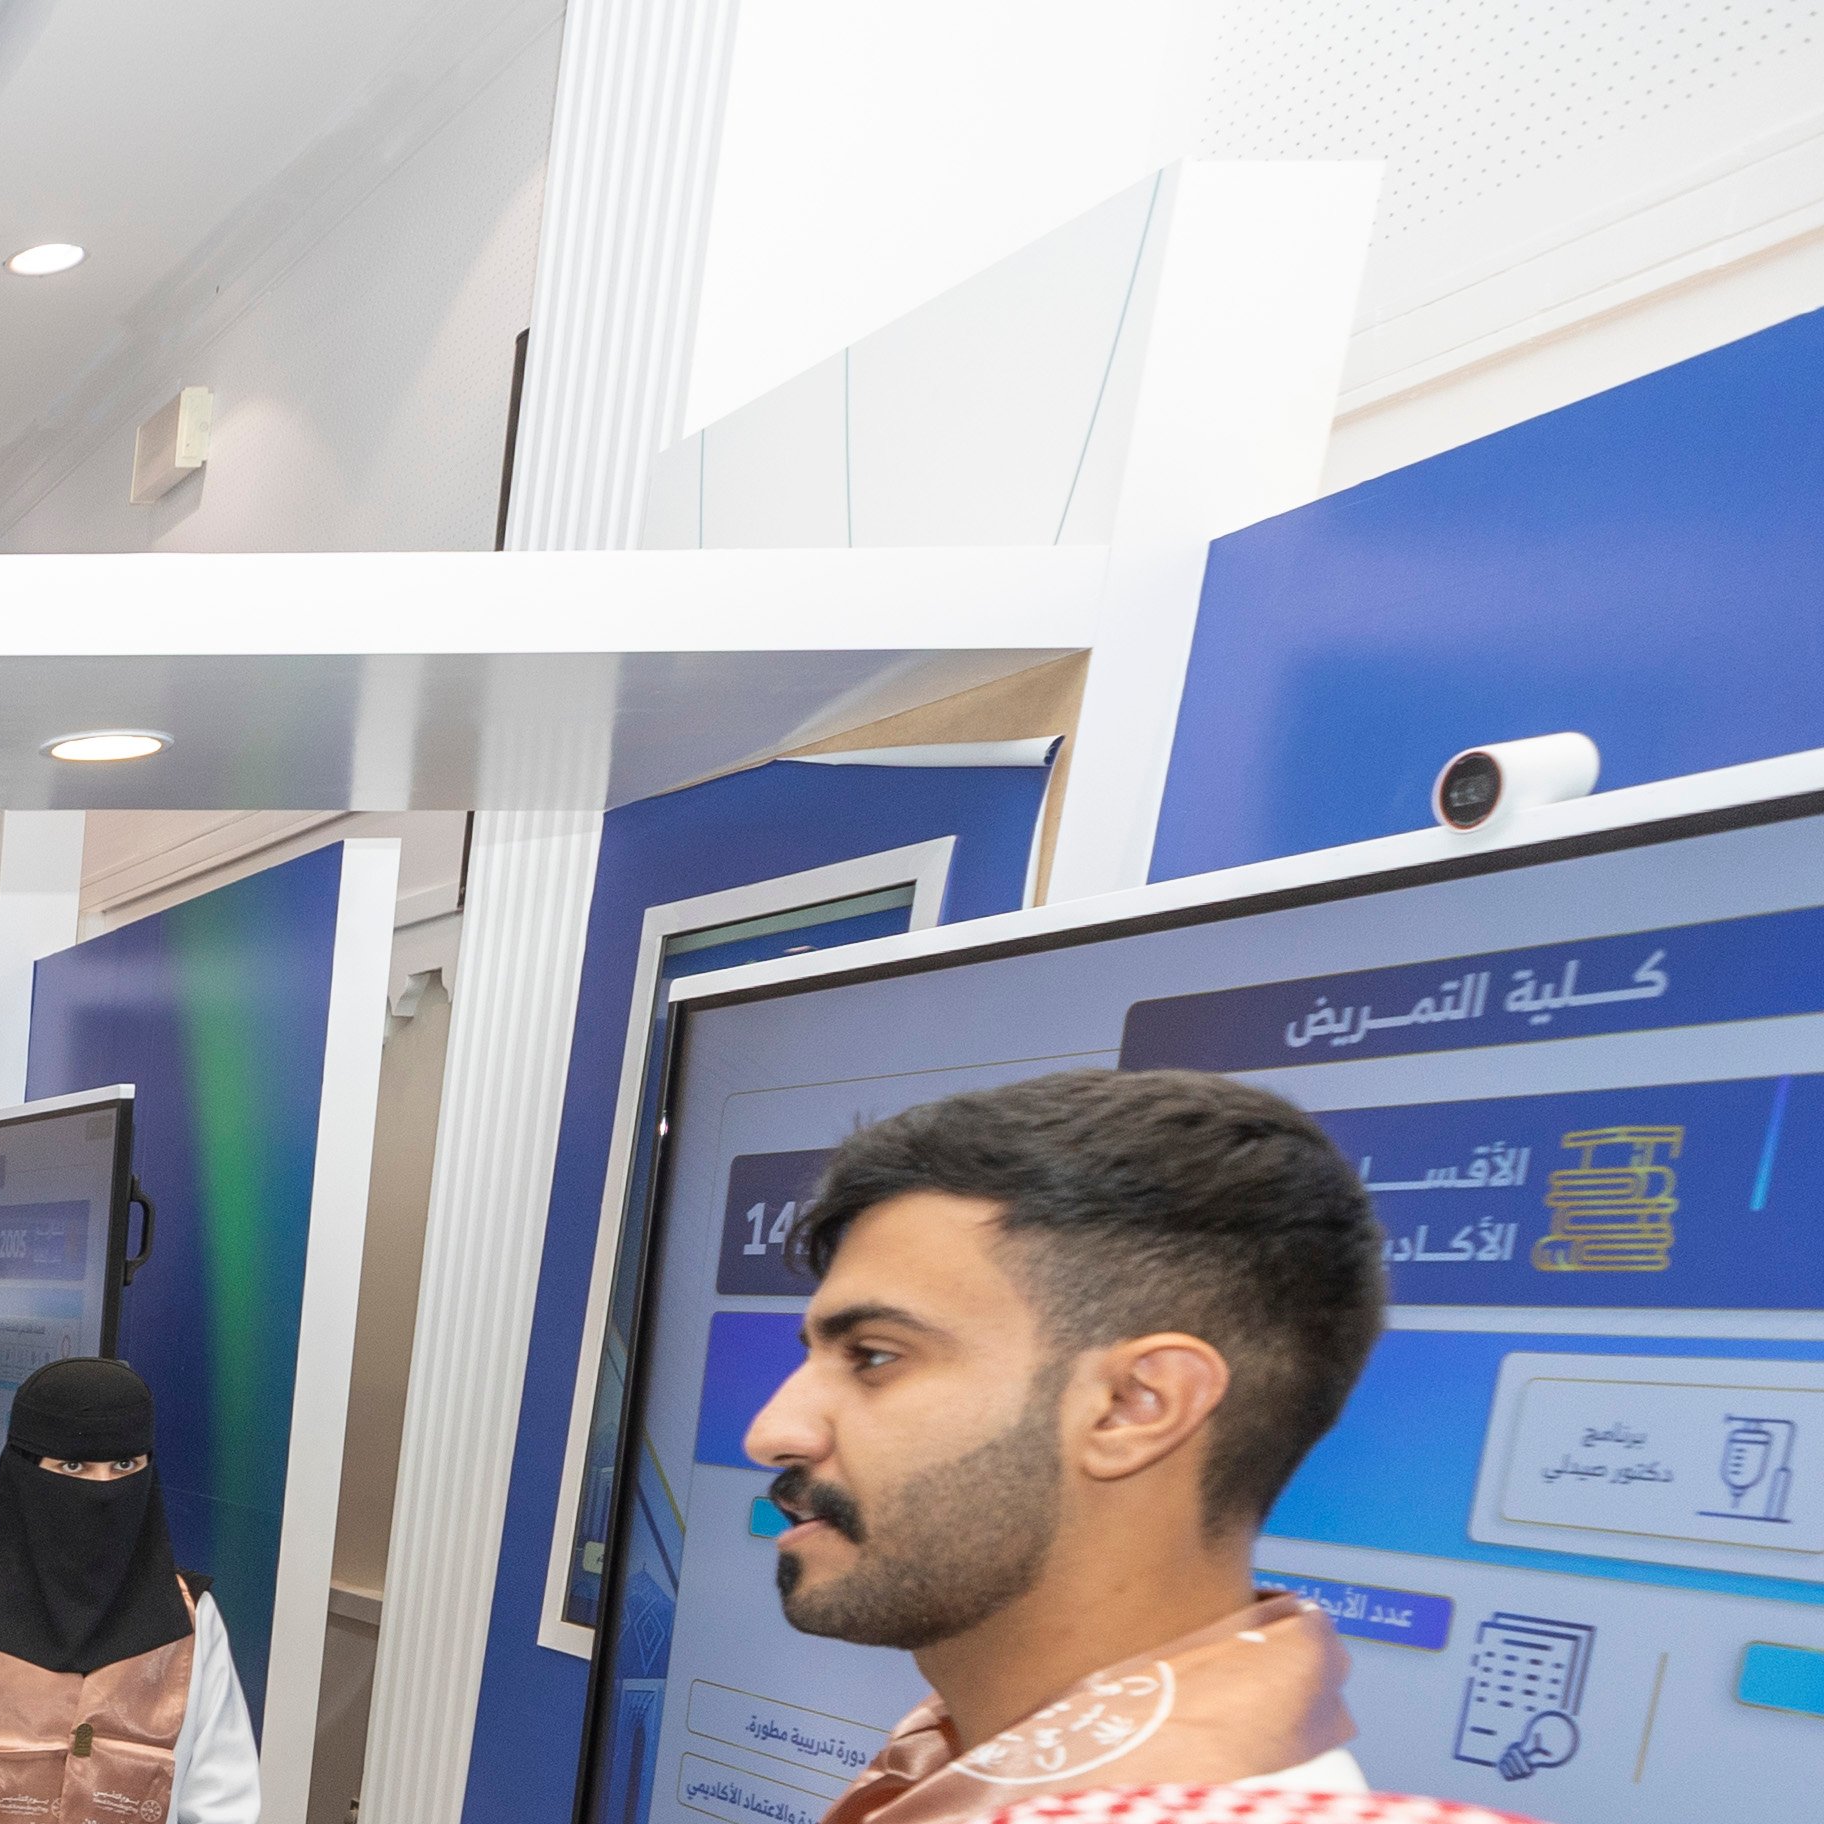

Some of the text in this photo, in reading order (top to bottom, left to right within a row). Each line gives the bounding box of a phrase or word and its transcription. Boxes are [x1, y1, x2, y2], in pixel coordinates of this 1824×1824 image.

[1283, 949, 1670, 1050] كلية التمريض
[1358, 1139, 1532, 1193] الأقسا
[1369, 1607, 1416, 1629] عدد
[790, 1727, 836, 1758] تدريبية
[836, 1739, 867, 1767] دورة
[685, 1781, 743, 1804] الأكاديمي
